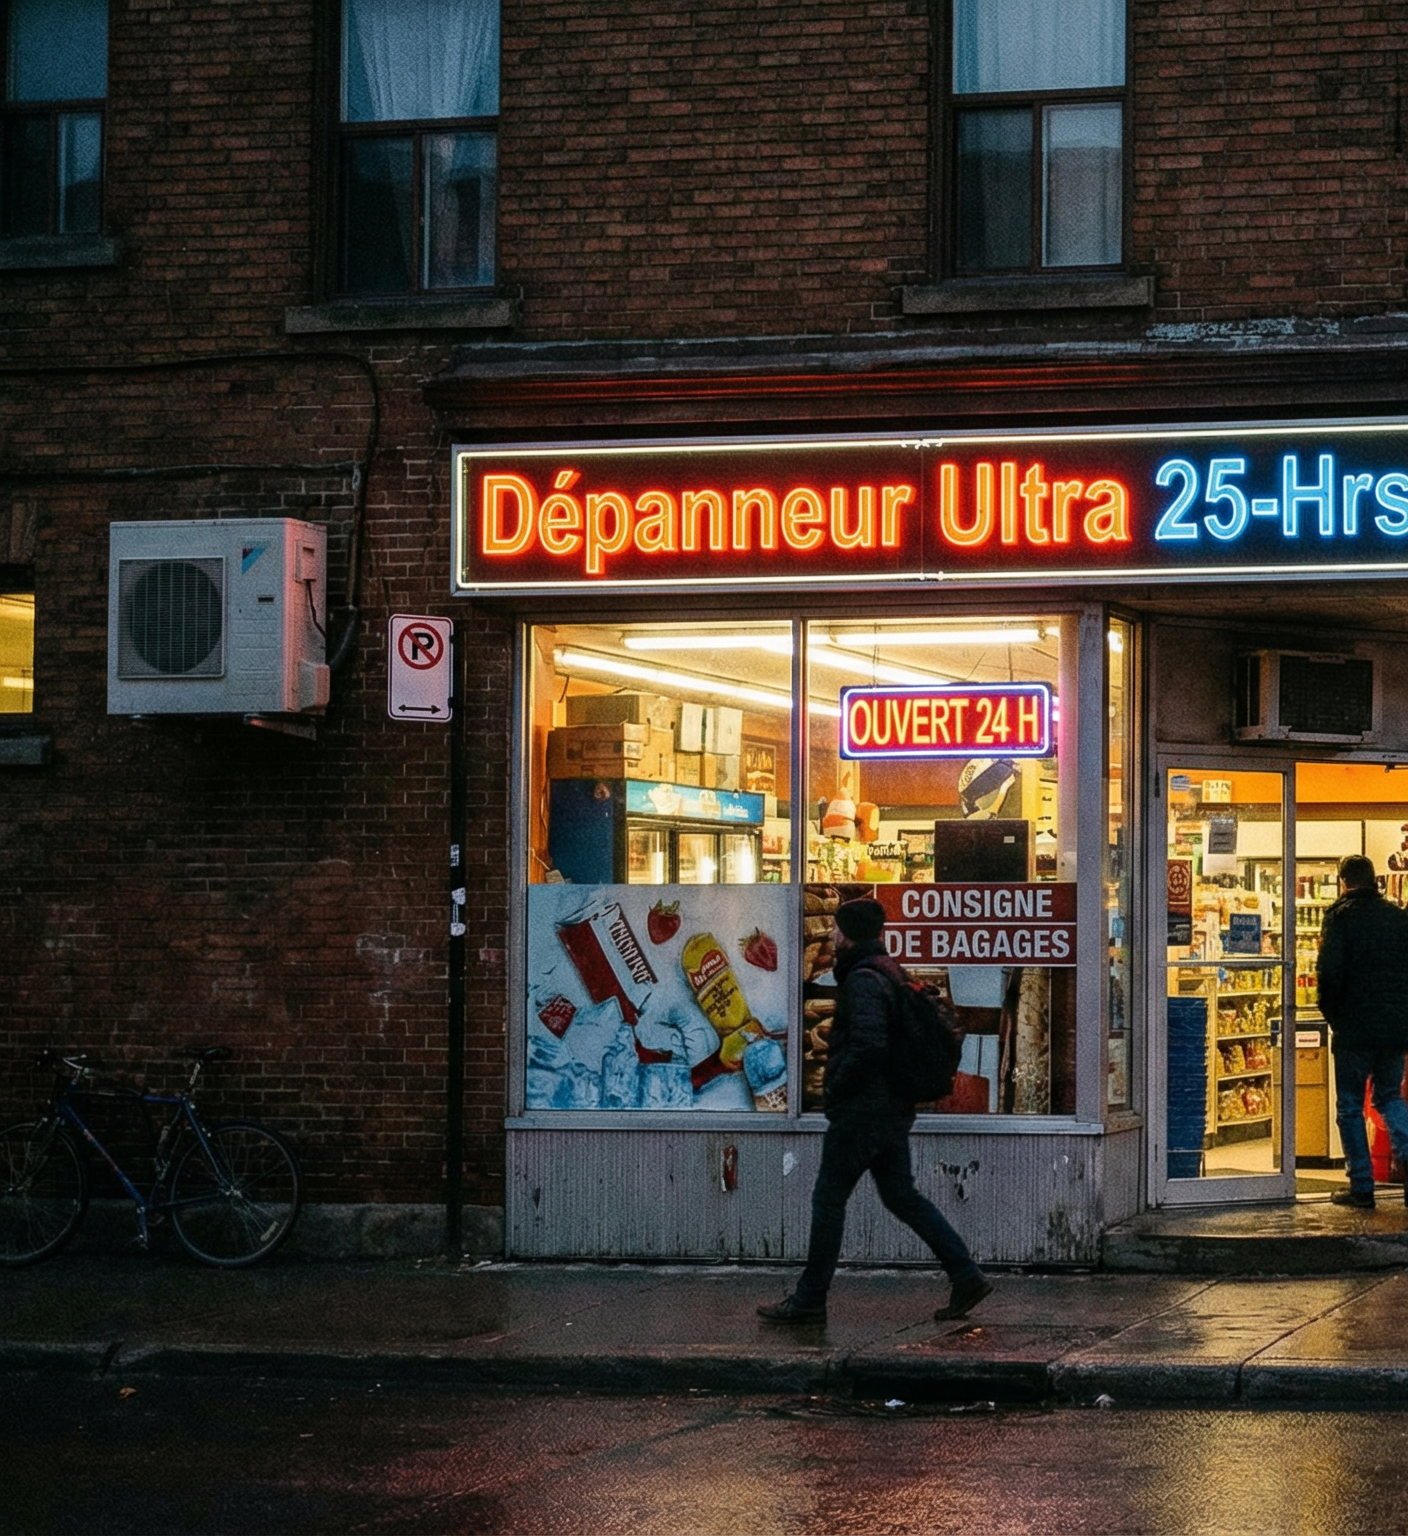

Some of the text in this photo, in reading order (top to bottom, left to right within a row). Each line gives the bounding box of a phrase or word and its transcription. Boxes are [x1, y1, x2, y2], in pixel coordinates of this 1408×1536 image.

[482, 470, 912, 574] Dépanneur
[940, 462, 1130, 546] Ultra
[849, 695, 1039, 746] OUVERT 24 H
[902, 889, 1053, 918] CONSIGNE
[884, 929, 1070, 958] DE BAGAGES
